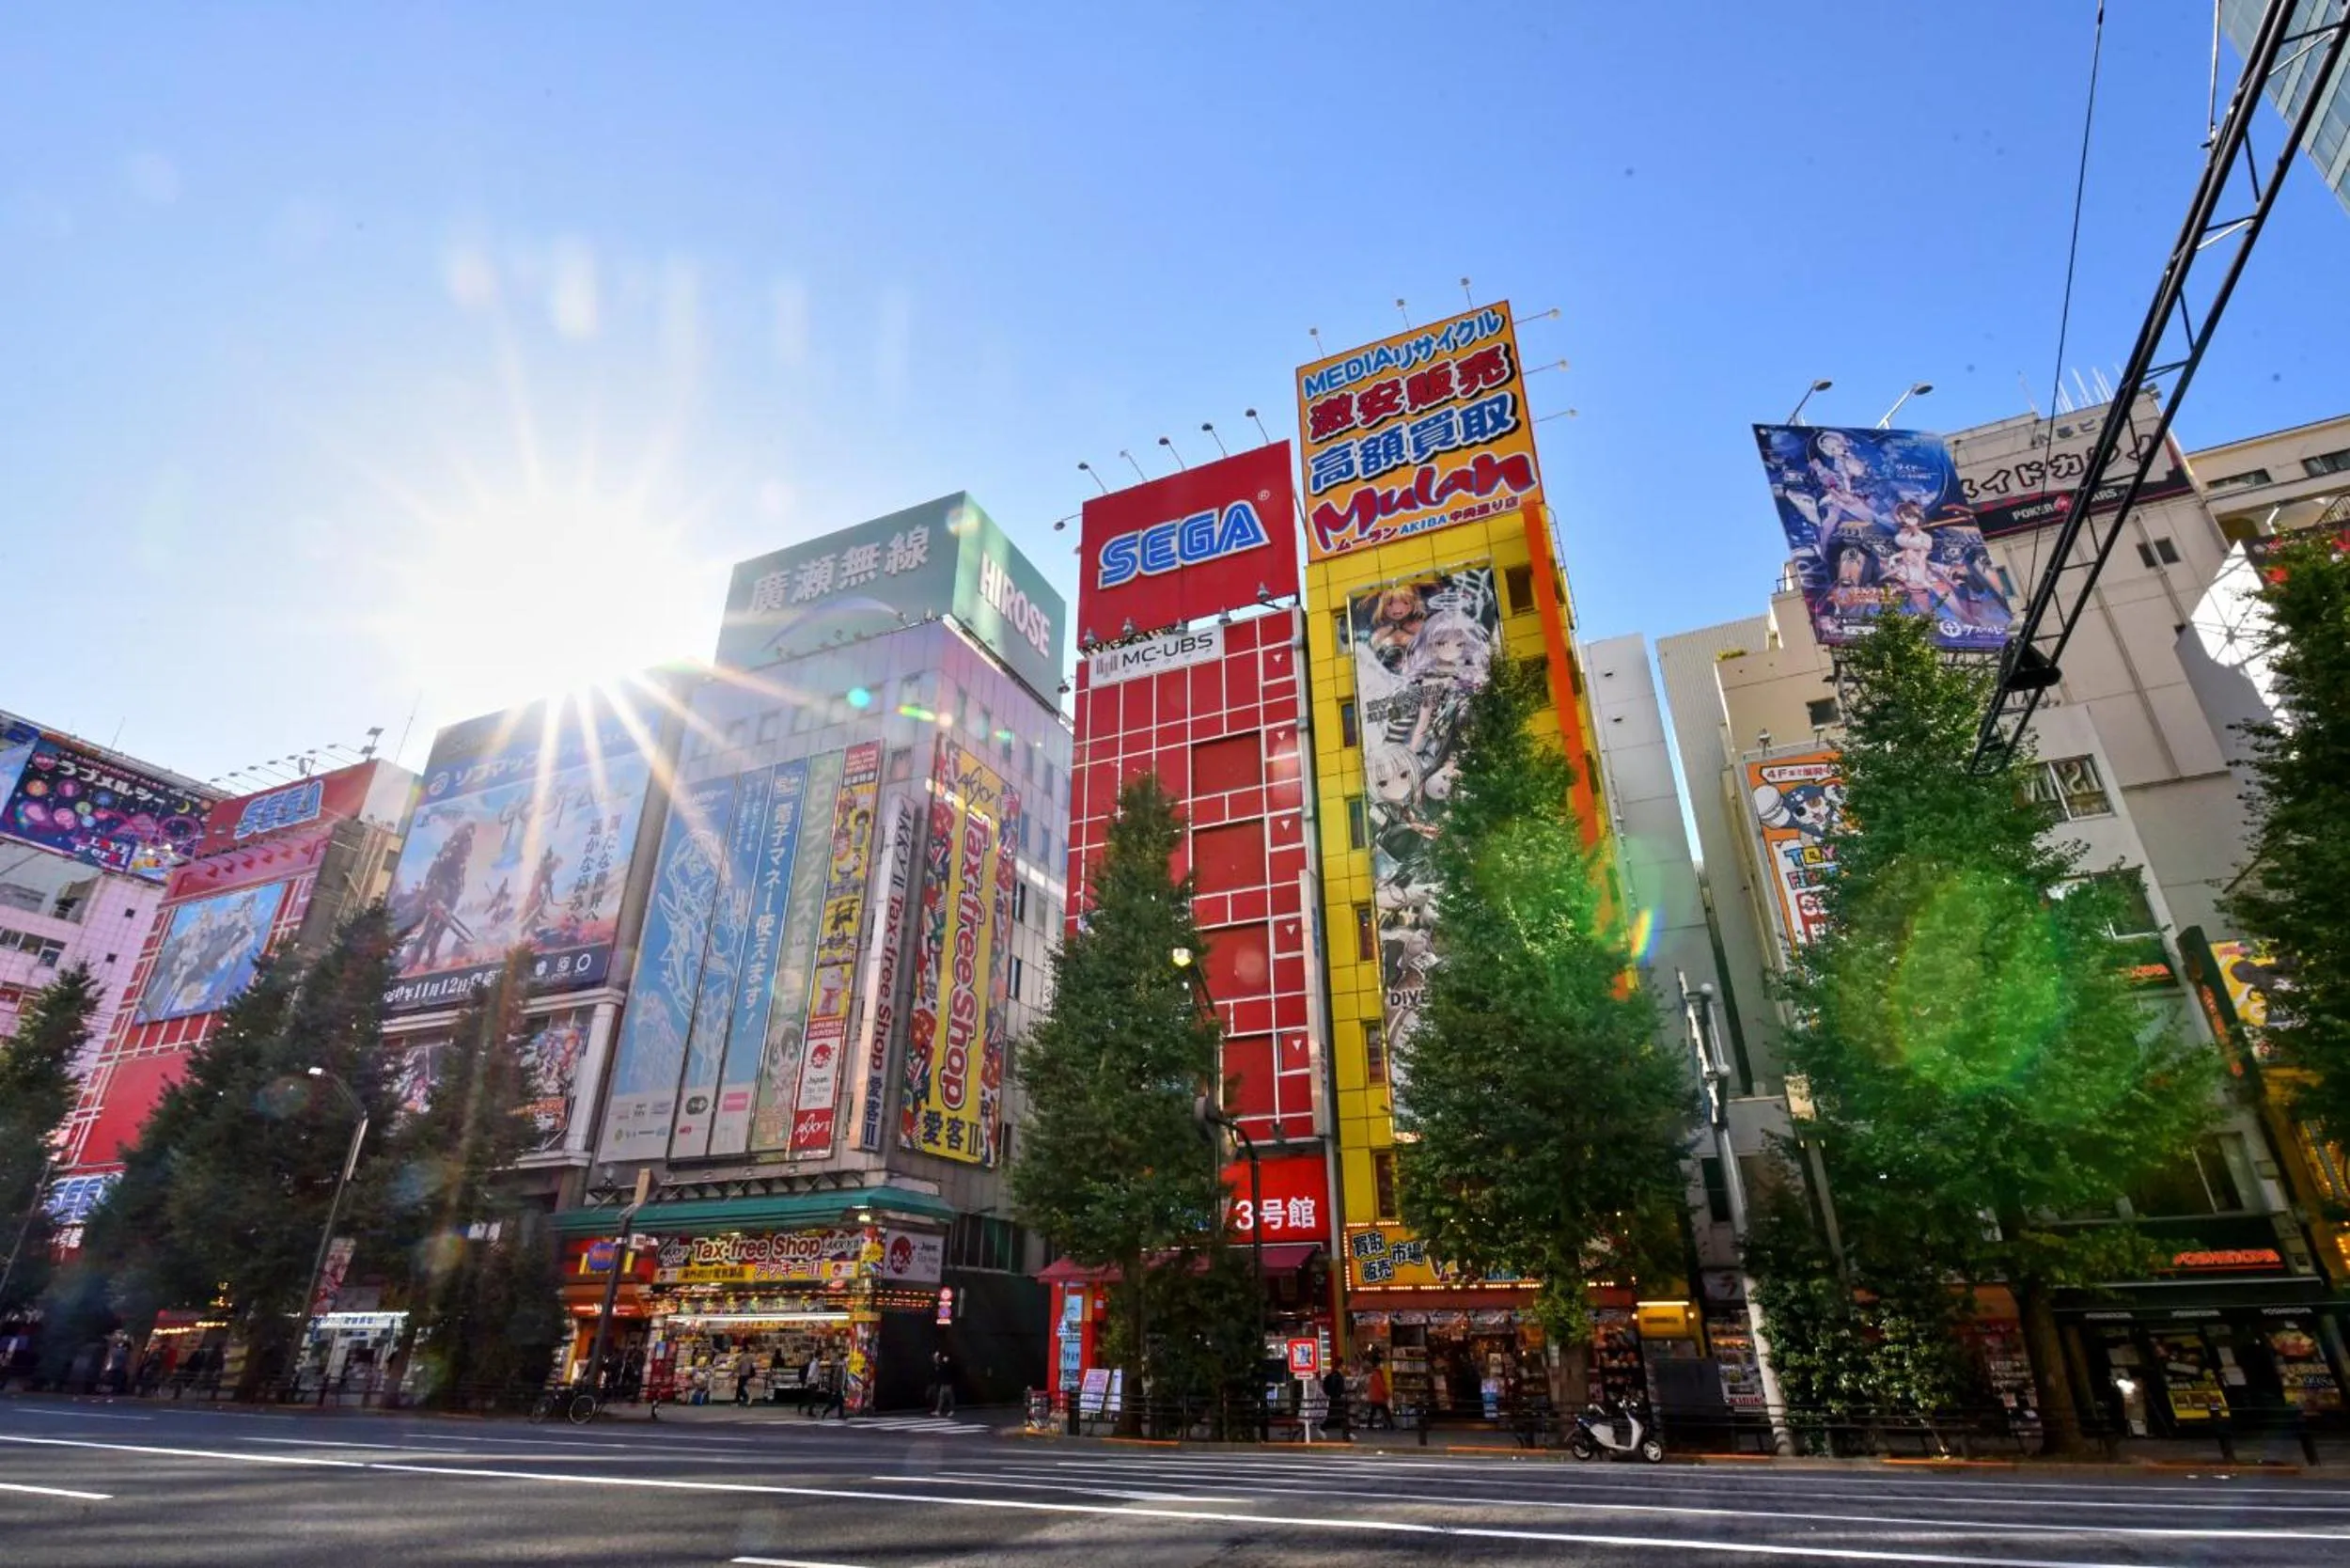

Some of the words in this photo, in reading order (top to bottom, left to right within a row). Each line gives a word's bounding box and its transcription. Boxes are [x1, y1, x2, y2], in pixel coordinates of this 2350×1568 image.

[1304, 310, 1502, 398] MEDIAリサイクル
[1309, 345, 1507, 442] 激安販売
[1310, 395, 1514, 493] 高額買取
[1311, 454, 1536, 551] Mulan
[1336, 527, 1398, 552] ムーラン
[1400, 515, 1448, 535] AKIBA
[1449, 496, 1519, 522] 中央通り店
[2012, 503, 2055, 522] POKER
[752, 524, 931, 613] 廣瀬無線
[1098, 500, 1271, 589] SEGA
[979, 551, 1050, 658] HIROSE
[1122, 633, 1214, 666] MC-UBS
[233, 778, 324, 839] SEGA
[953, 811, 993, 985] Tax-free
[871, 1003, 892, 1071] Shop
[940, 986, 979, 1111] Shop
[692, 1237, 770, 1262] Tax-free
[773, 1233, 822, 1260] Shop
[1235, 1197, 1316, 1231] 3号館
[1353, 1222, 1386, 1257] 買取
[1362, 1258, 1393, 1282] 販売
[1391, 1241, 1425, 1264] 市場
